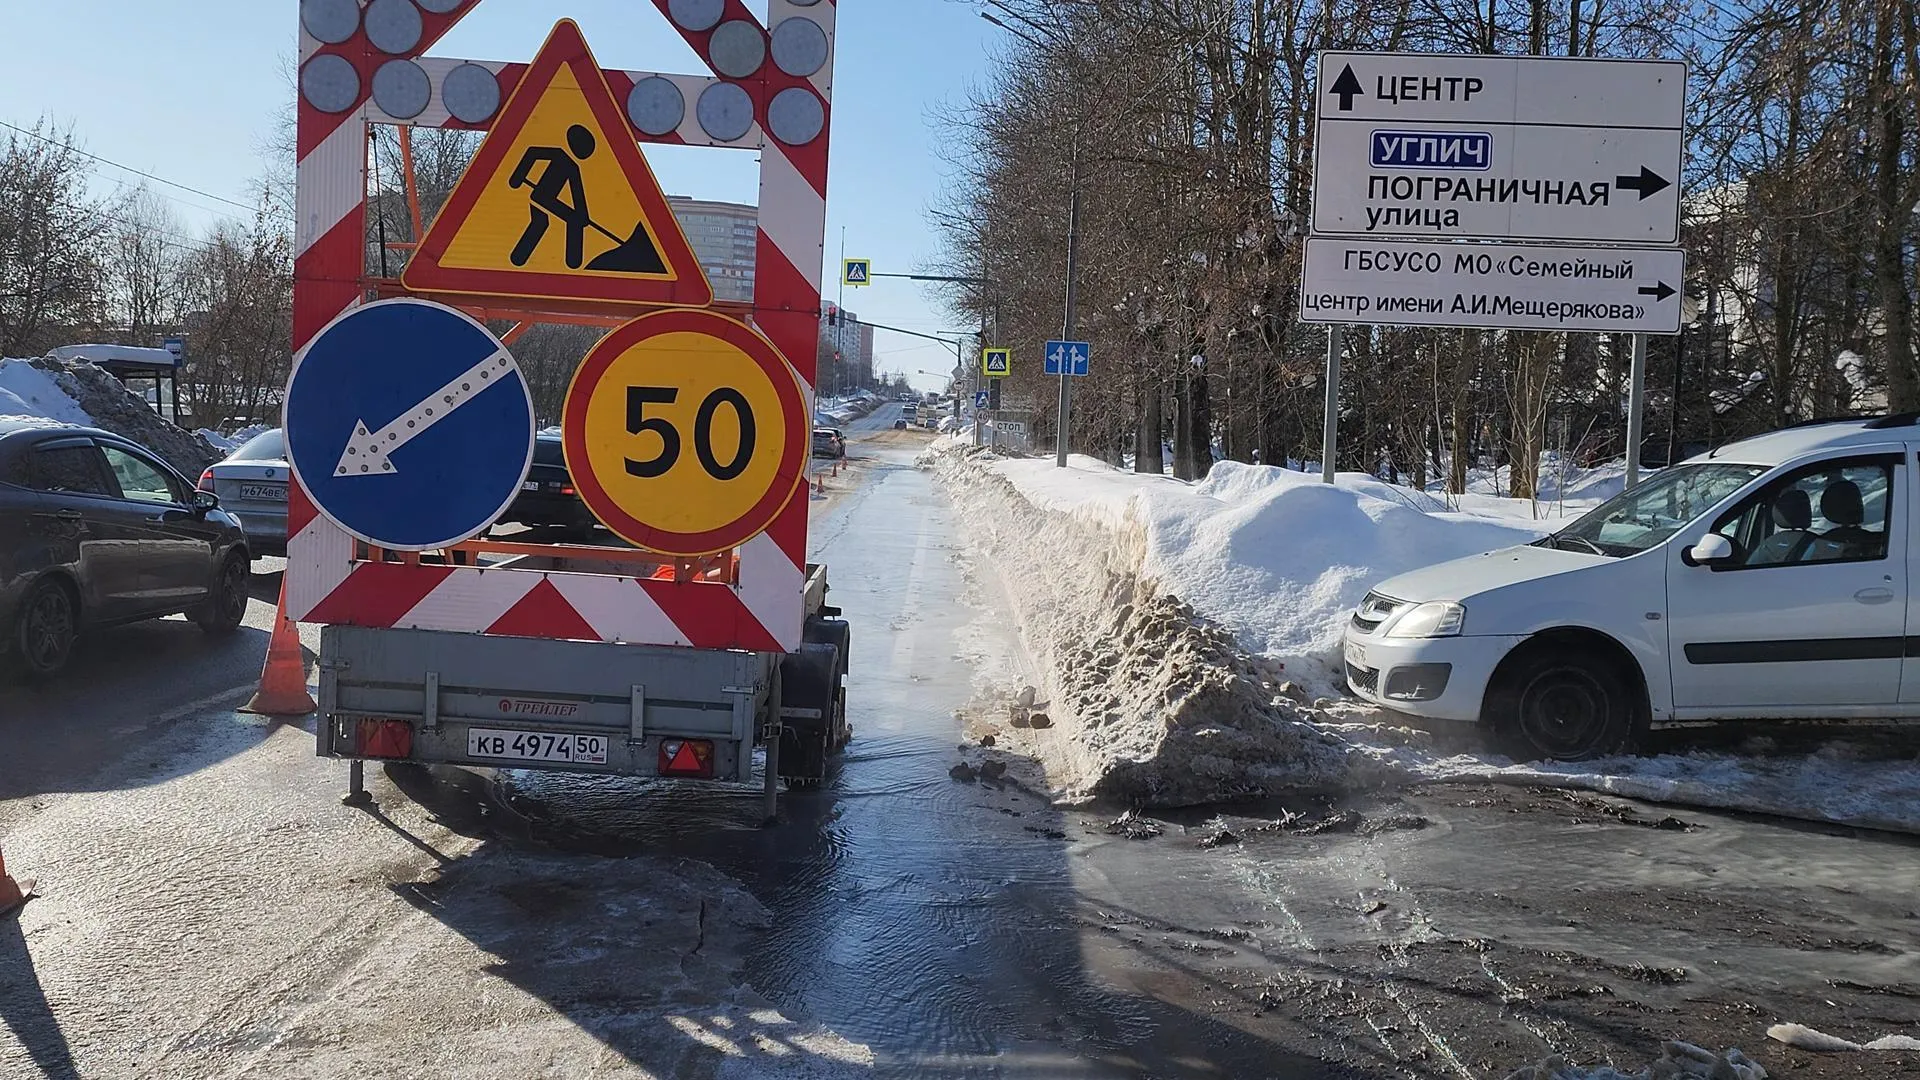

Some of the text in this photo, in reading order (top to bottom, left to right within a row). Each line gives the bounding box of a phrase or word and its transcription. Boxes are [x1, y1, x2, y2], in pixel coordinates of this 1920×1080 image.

[1376, 75, 1484, 105] ЦЕНТР
[1379, 136, 1484, 164] УГЛИЧ
[1367, 175, 1610, 207] ПОГРАНИЧНАЯ
[1365, 206, 1460, 231] улица
[1343, 250, 1442, 274] ГБСУСО
[1305, 293, 1645, 323] центр имени А.И.Мещерякова»
[623, 385, 757, 481] 50
[513, 700, 578, 717] ТРЕЙЛЕР
[476, 733, 600, 759] КВ 4974 50
[574, 753, 592, 761] RUS
